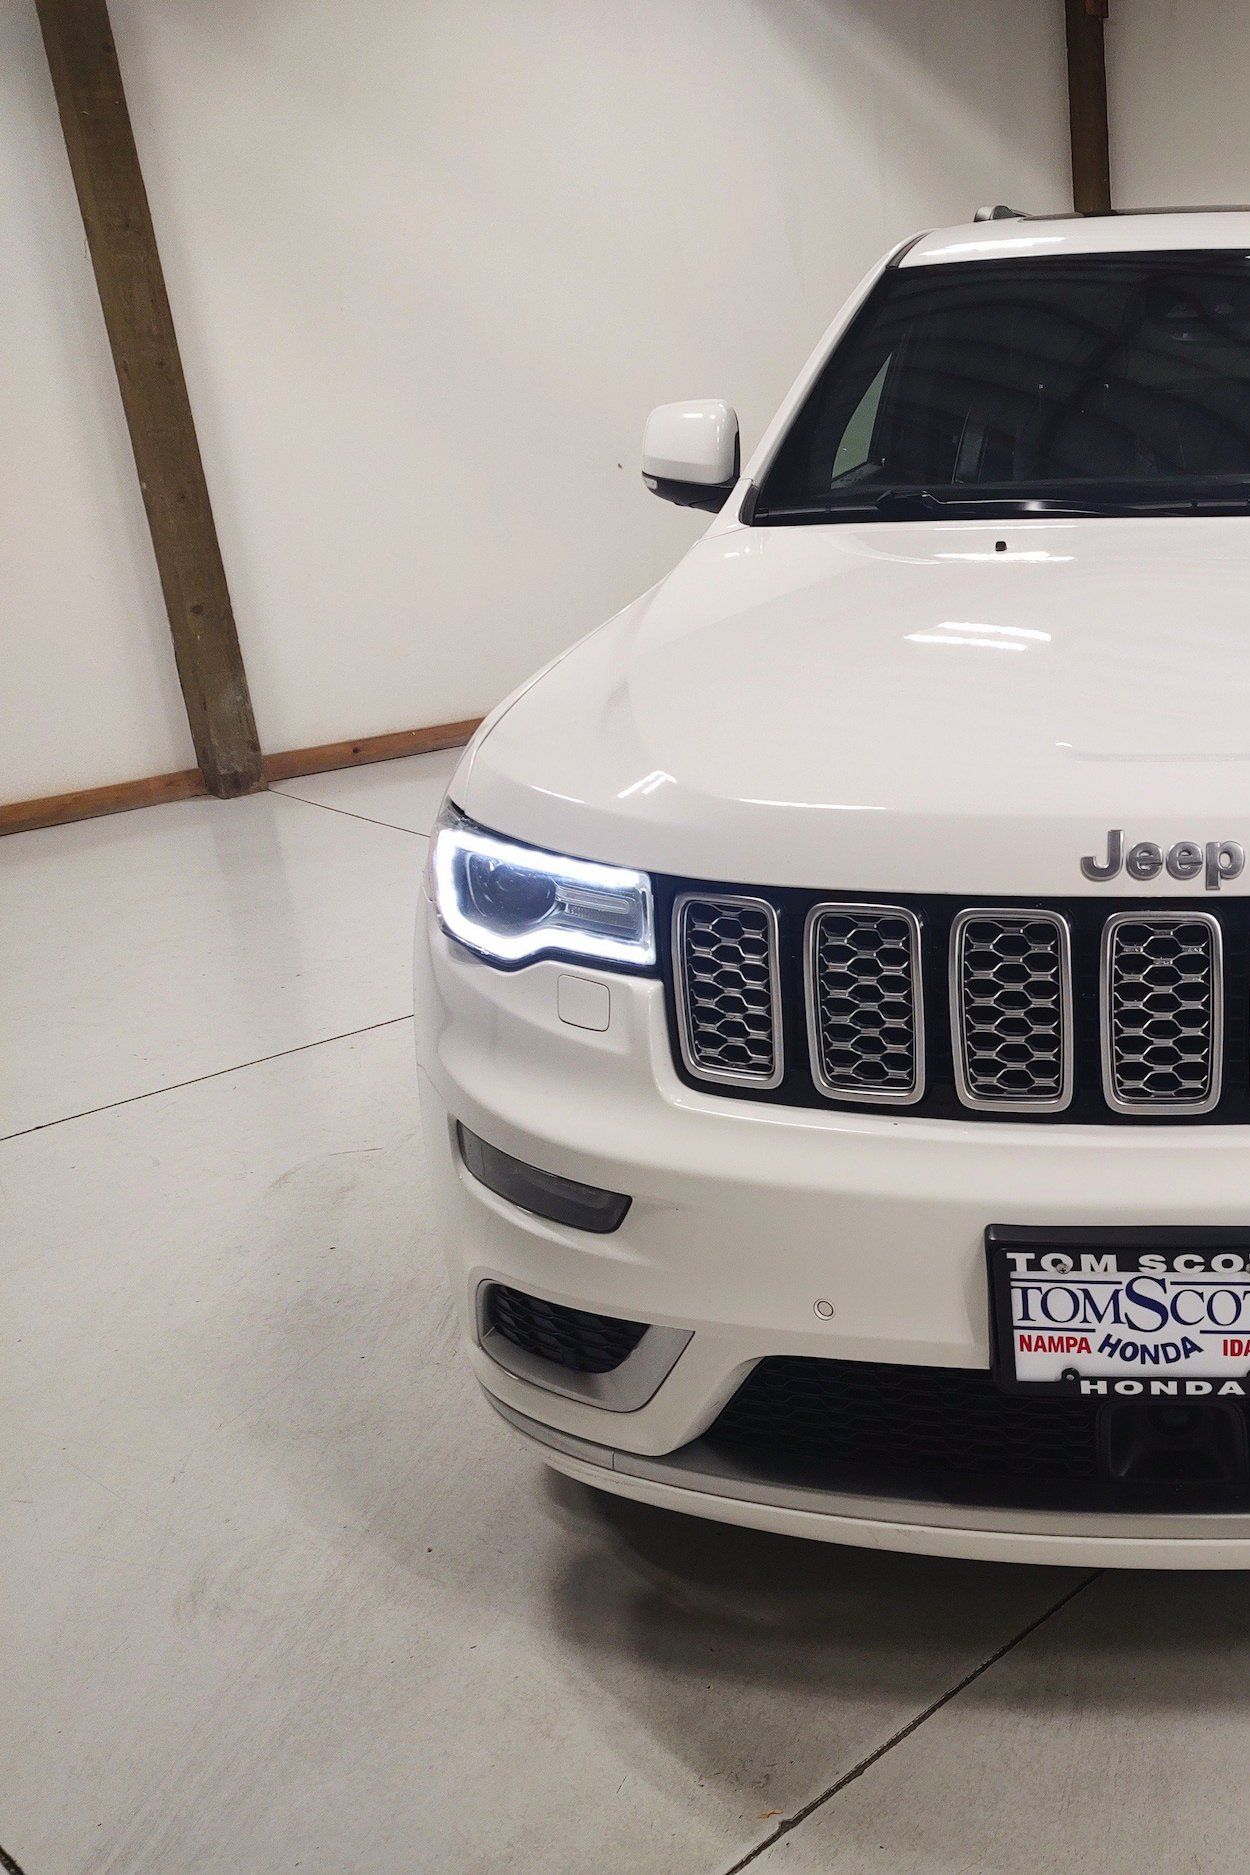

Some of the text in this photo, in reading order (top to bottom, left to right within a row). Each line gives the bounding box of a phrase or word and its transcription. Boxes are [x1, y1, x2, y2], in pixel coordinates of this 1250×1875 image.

[1080, 829, 1246, 891] Jeep
[1006, 1252, 1118, 1273] TOM
[1018, 1334, 1092, 1354] NAMPA
[1098, 1334, 1204, 1365] HONDA
[1080, 1380, 1247, 1396] HONDA
